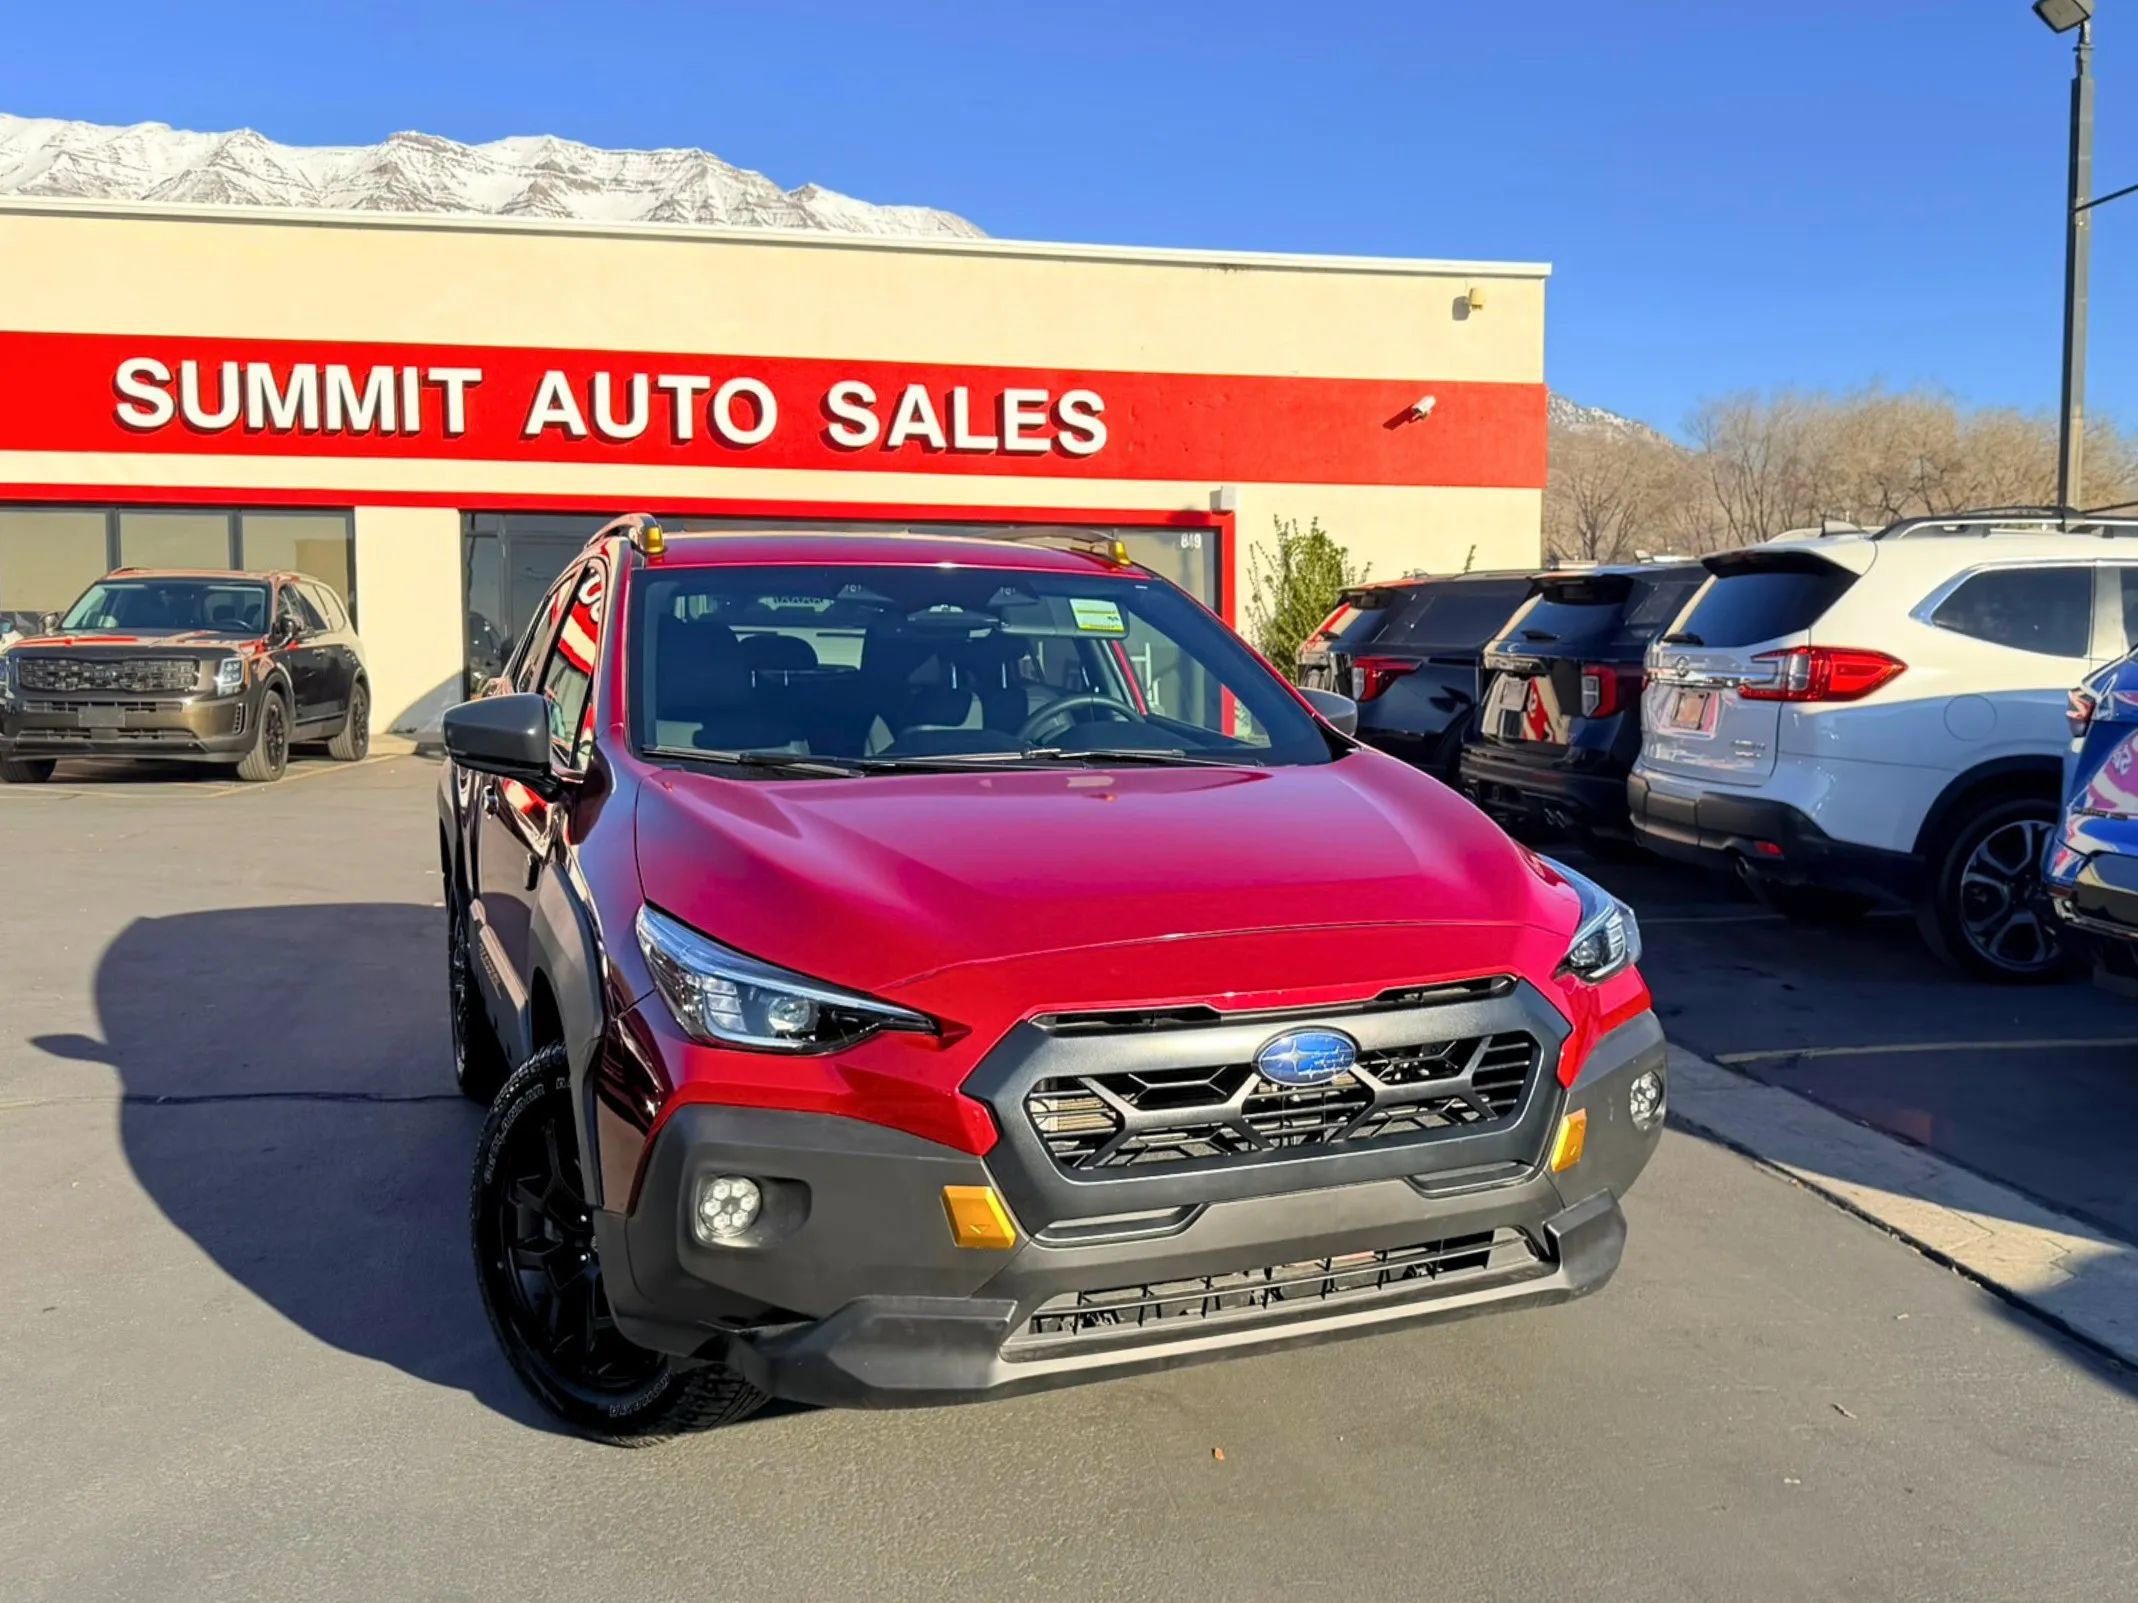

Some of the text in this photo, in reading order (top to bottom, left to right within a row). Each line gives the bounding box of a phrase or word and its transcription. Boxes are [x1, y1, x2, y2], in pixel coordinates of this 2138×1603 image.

[114, 356, 1108, 455] SUMMIT AUTO SALES
